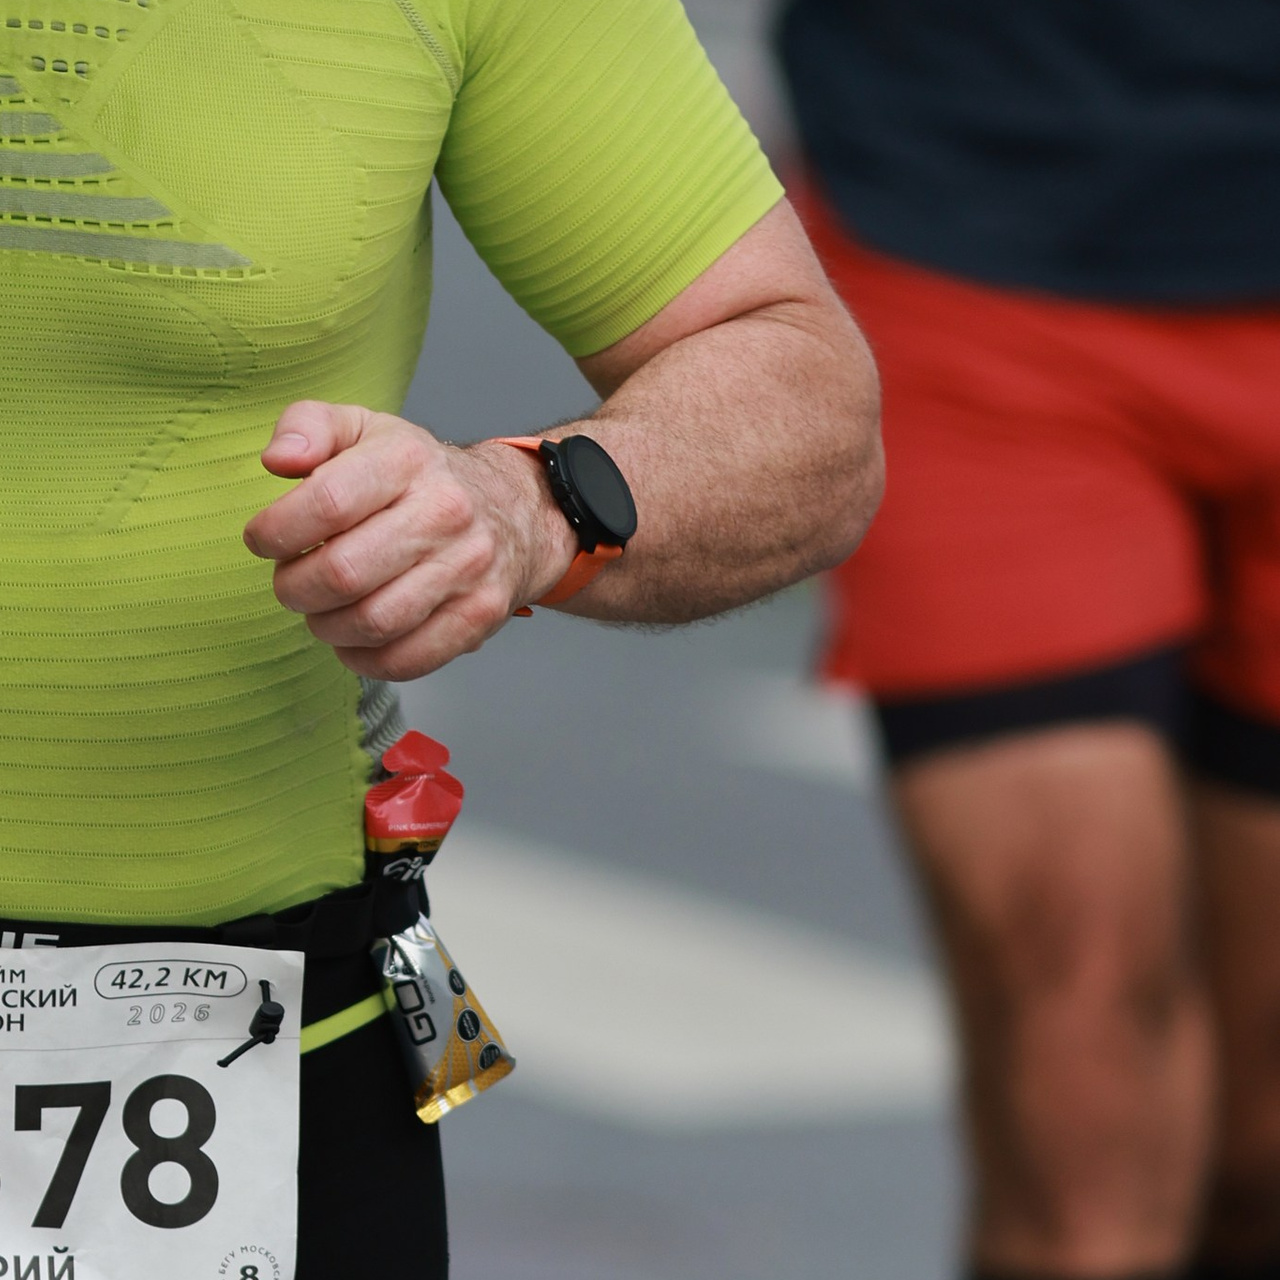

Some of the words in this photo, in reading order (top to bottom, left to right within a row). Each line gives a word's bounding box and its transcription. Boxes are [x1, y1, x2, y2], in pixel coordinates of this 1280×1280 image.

[388, 823, 409, 832] PINK
[111, 967, 171, 991] 42,2
[126, 1002, 211, 1026] 2026
[393, 979, 437, 1046] GO
[218, 1250, 236, 1275] БЕГУ
